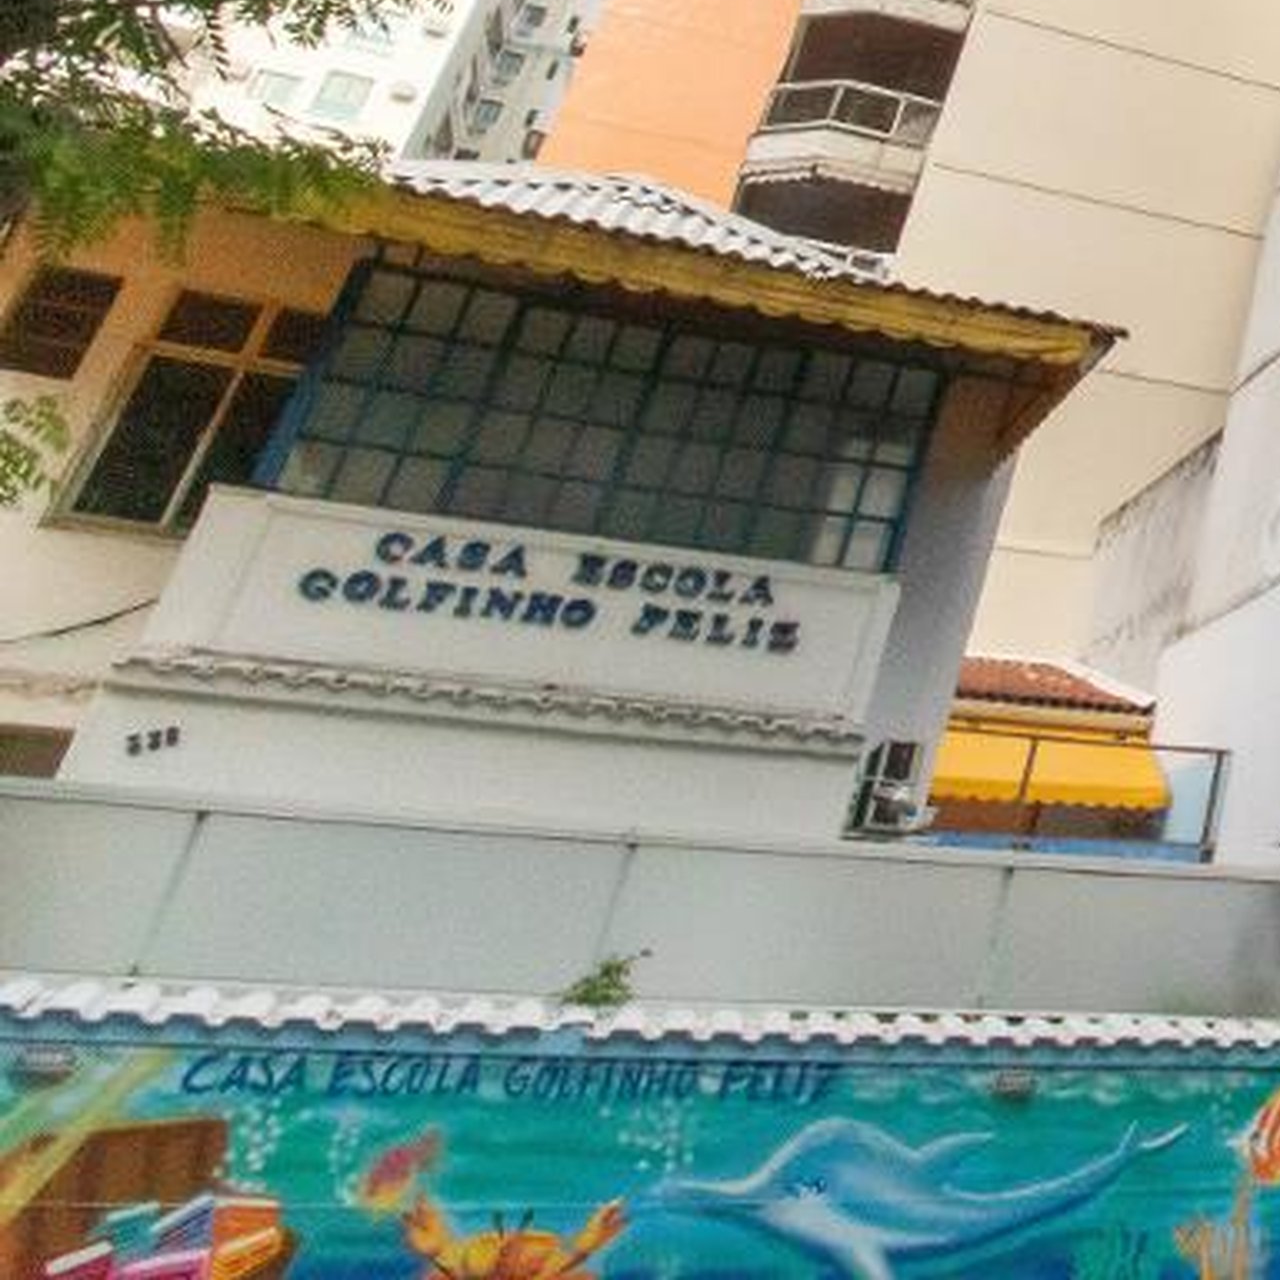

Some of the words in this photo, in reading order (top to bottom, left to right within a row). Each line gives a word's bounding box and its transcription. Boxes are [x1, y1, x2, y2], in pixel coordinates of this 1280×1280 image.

[375, 531, 528, 579] CASA
[570, 552, 775, 608] ESCOLA
[299, 567, 597, 629] GOLFINHO
[631, 603, 800, 653] FELIZ
[182, 1053, 308, 1094] CASA
[326, 1052, 481, 1096] ESCOLA
[503, 1058, 698, 1100] GOLFINHO
[718, 1061, 838, 1101] FELIZ
